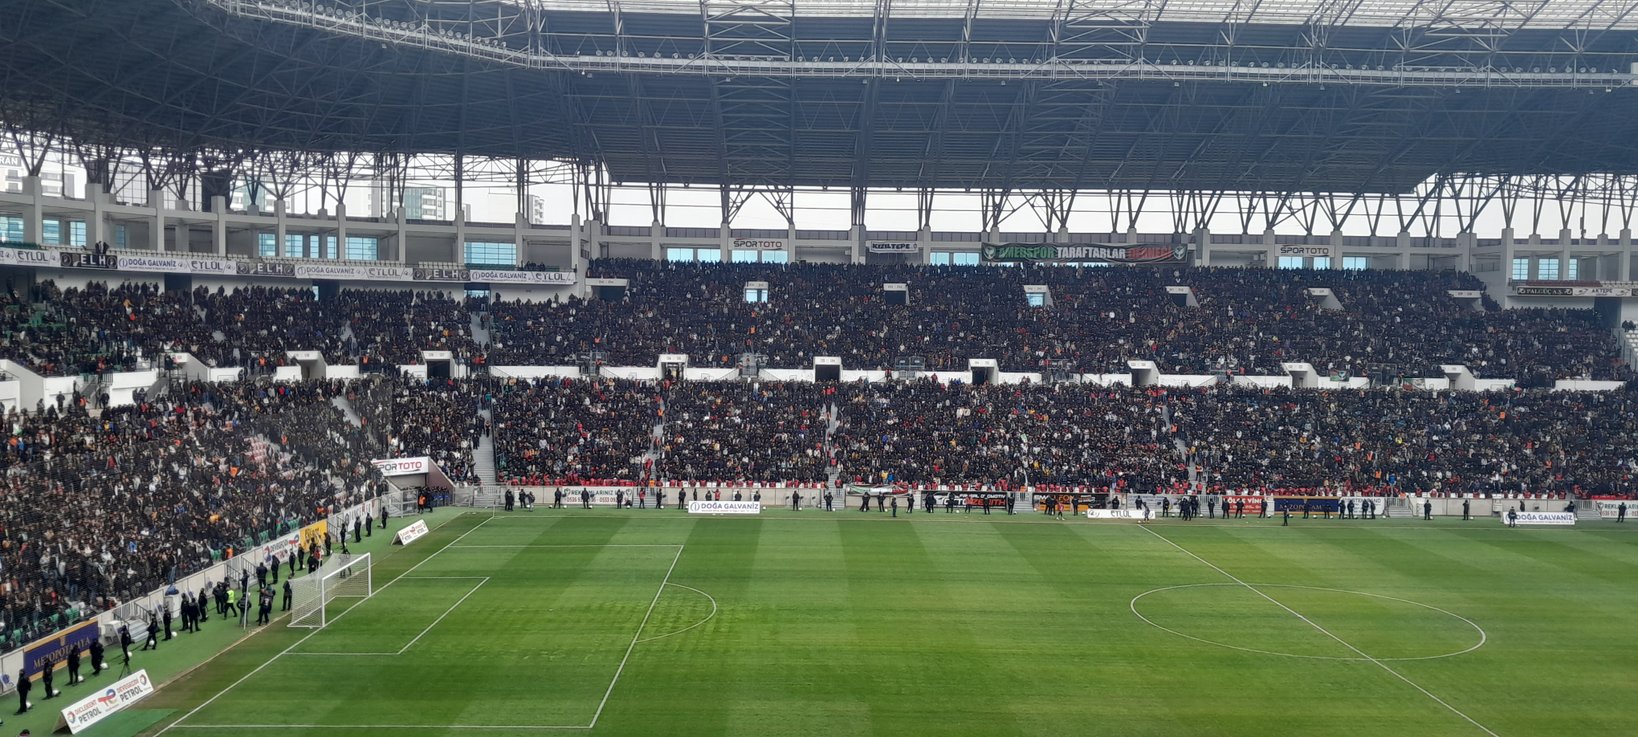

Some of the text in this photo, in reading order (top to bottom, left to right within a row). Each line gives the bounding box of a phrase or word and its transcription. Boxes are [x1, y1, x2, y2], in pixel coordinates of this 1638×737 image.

[1056, 246, 1126, 259] TARAFTARLAR
[128, 257, 177, 267] DOĞA GALVANİZ
[701, 502, 759, 510] DOĞA GALVANİZ
[78, 707, 102, 724] PETROL
[119, 686, 144, 703] PETROL
